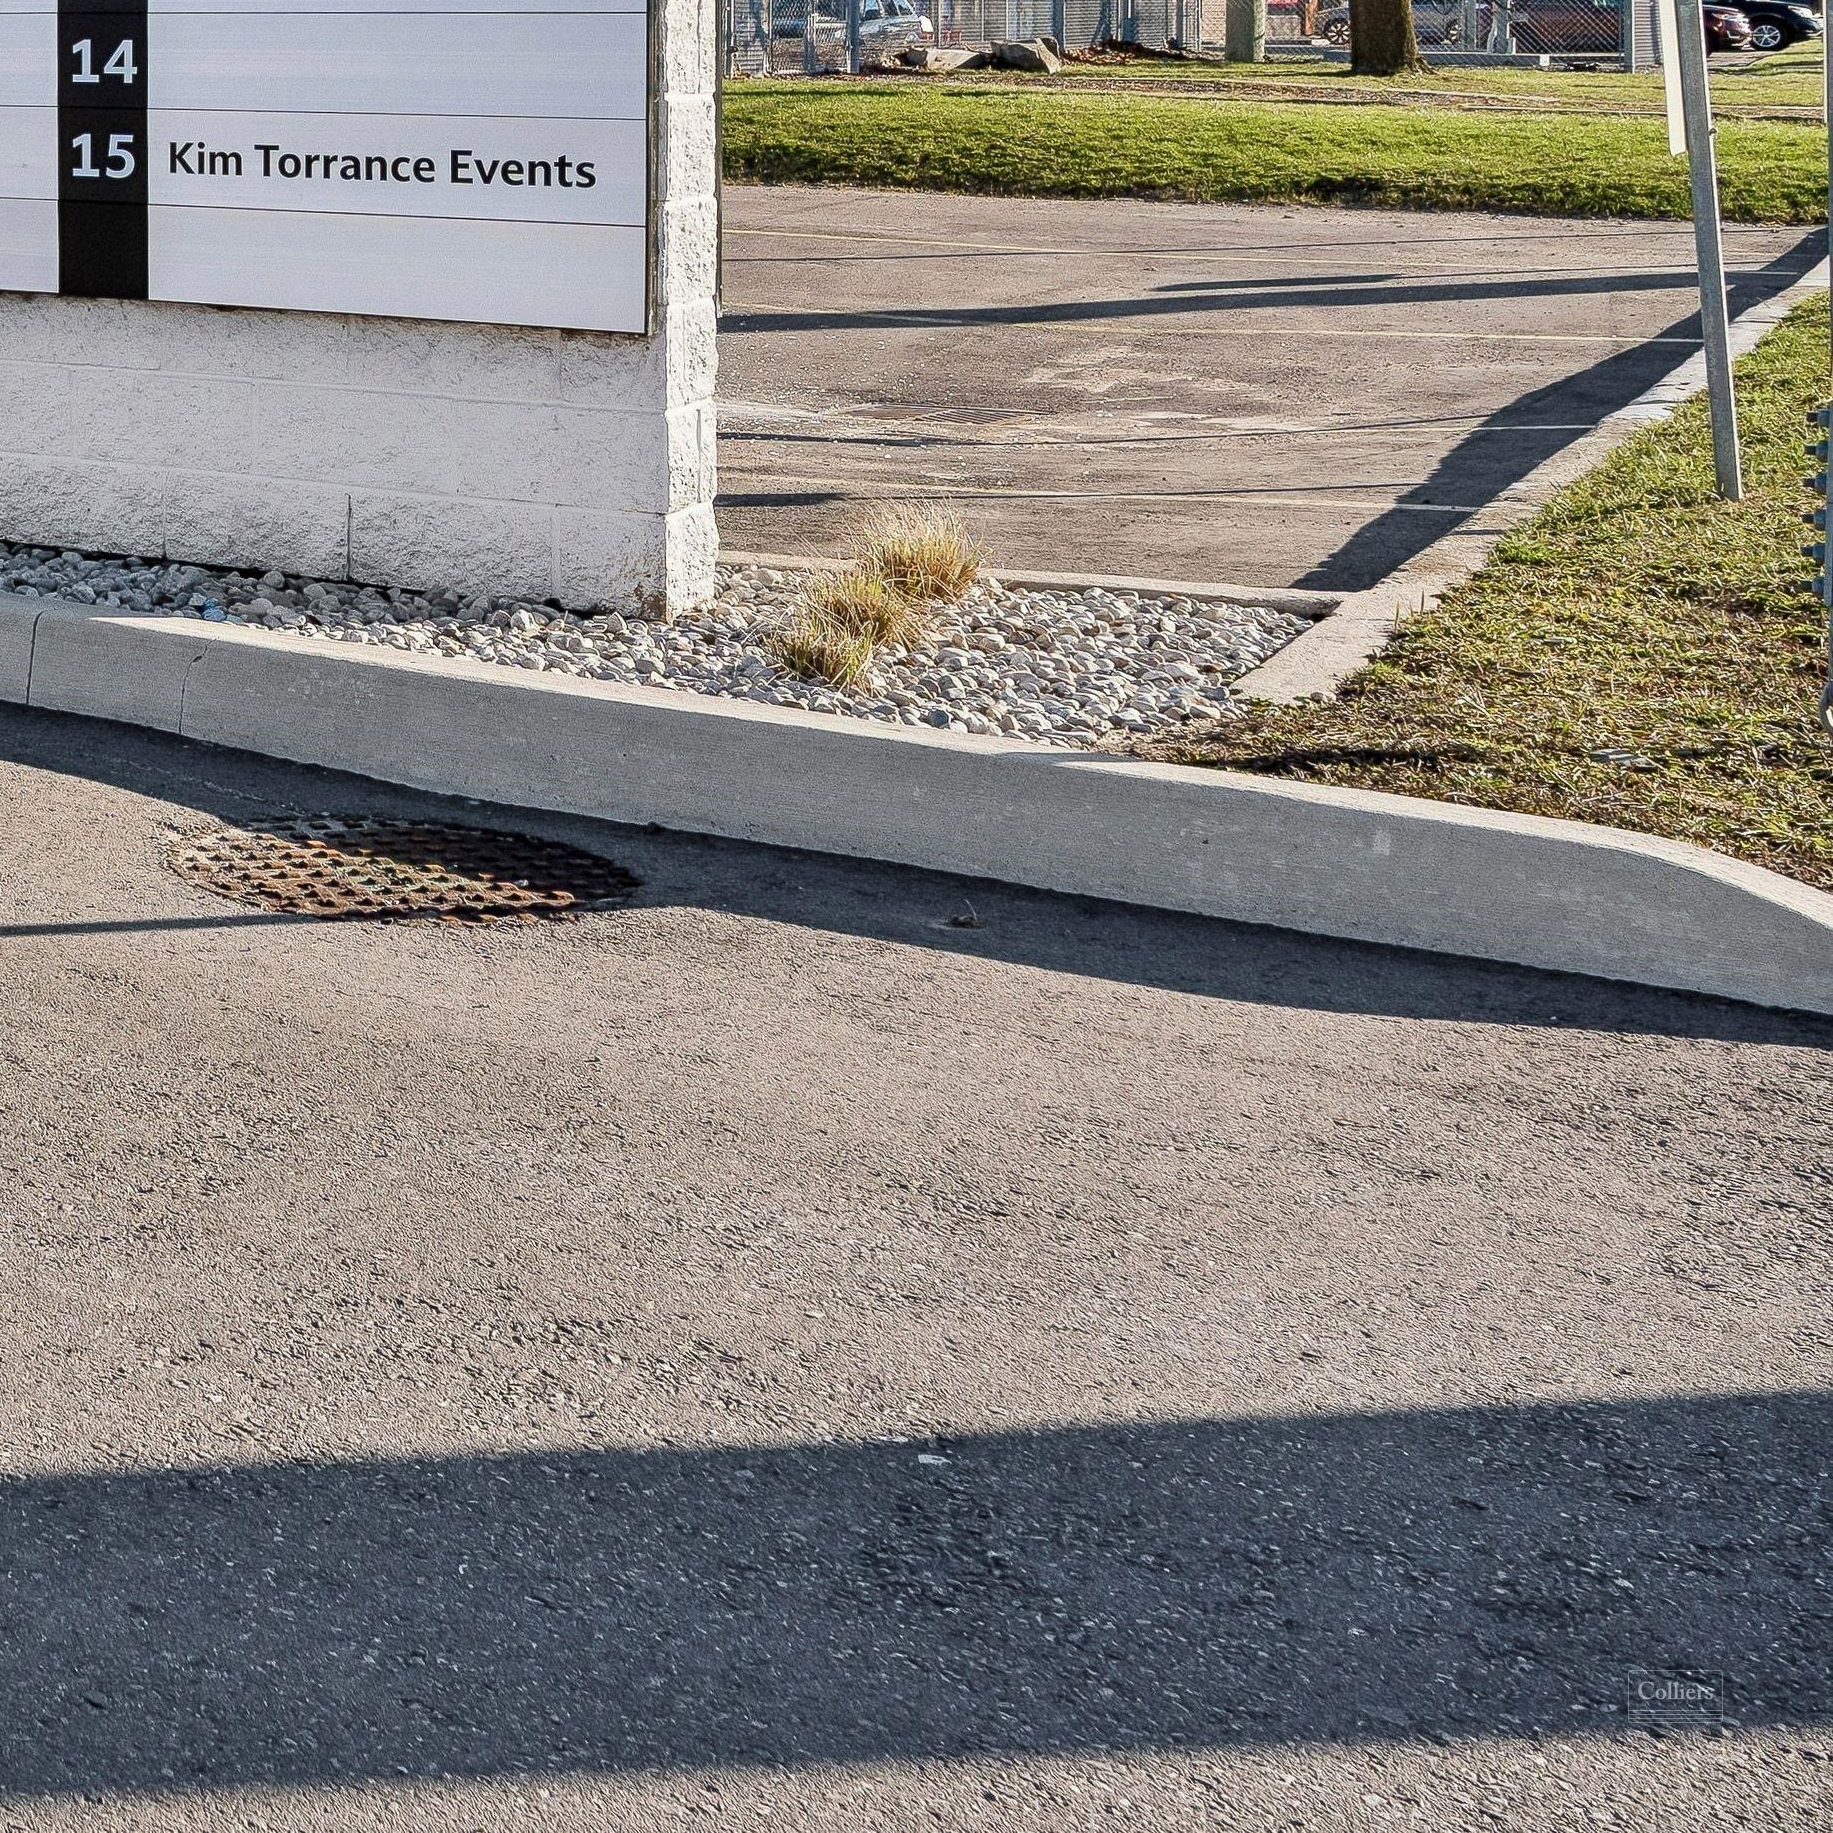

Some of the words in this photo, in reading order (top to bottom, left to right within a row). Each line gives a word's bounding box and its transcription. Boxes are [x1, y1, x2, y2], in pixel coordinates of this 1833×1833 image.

[72, 38, 138, 84] 14
[72, 133, 136, 179] 15
[169, 141, 243, 176] Kim
[253, 144, 436, 183] Torrance
[450, 149, 596, 189] Events
